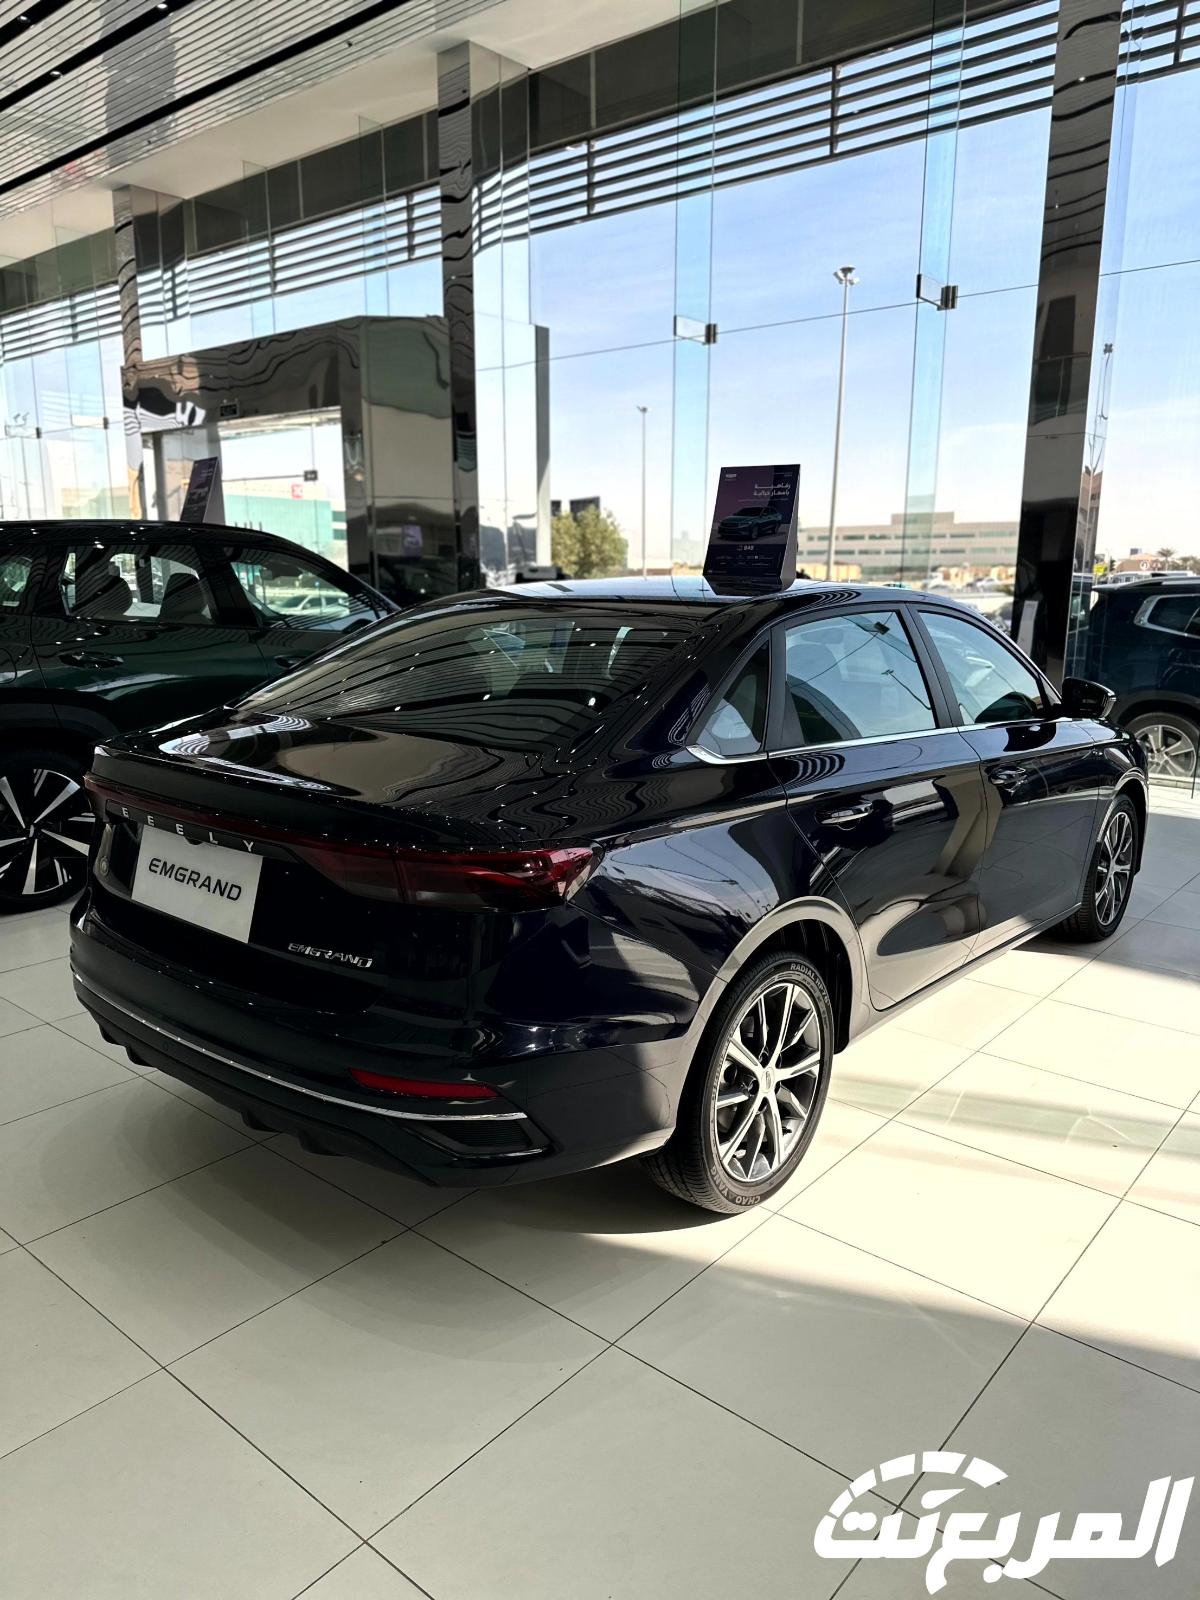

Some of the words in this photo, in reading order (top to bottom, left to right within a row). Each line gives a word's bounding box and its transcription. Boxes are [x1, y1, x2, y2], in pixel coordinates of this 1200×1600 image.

[121, 807, 254, 852] GEELY
[148, 857, 242, 902] EMGRAND
[288, 942, 374, 969] EMGRAND
[790, 963, 815, 980] RADIAL
